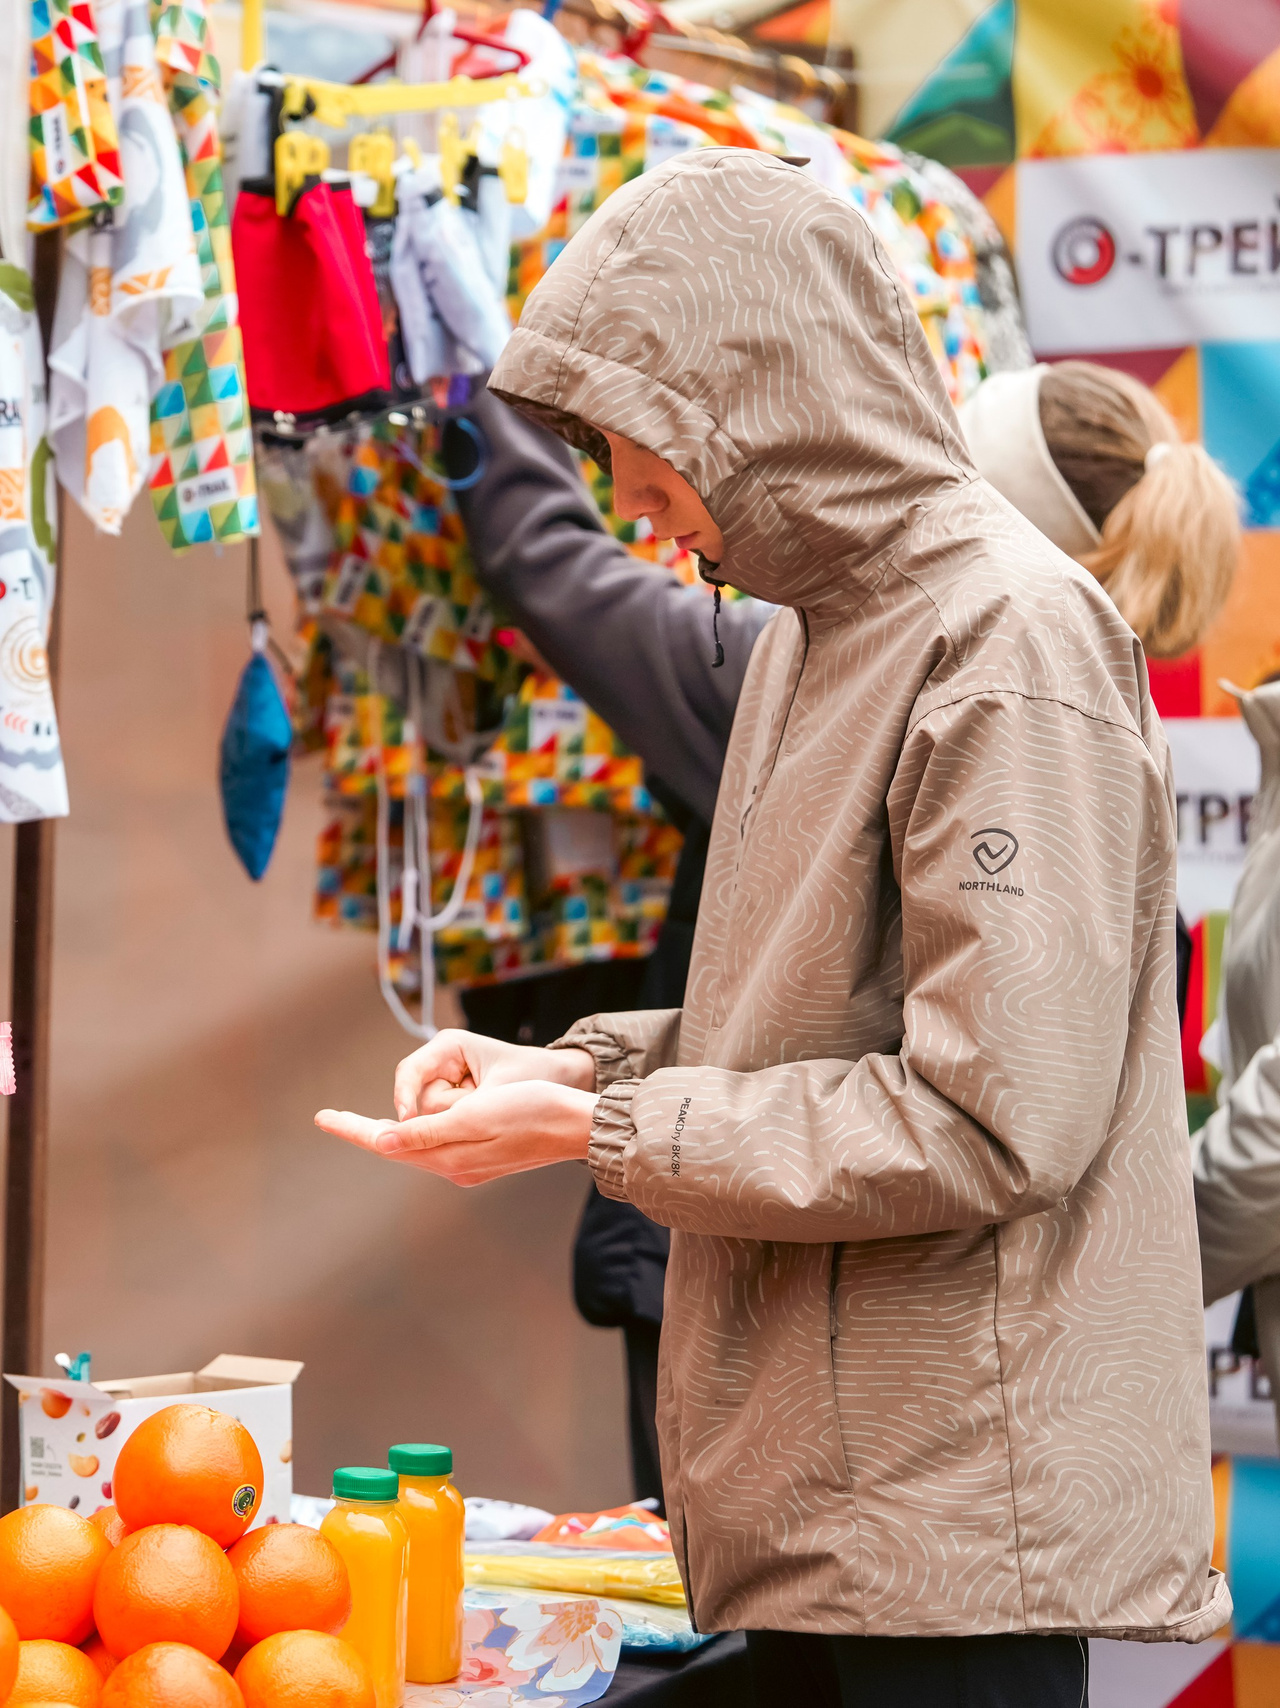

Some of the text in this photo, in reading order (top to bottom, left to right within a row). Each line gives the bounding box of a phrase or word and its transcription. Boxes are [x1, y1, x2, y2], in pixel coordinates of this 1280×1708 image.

[958, 881, 1025, 897] NORTHLAND
[670, 1097, 692, 1177] PEAKDry 8K/8K
